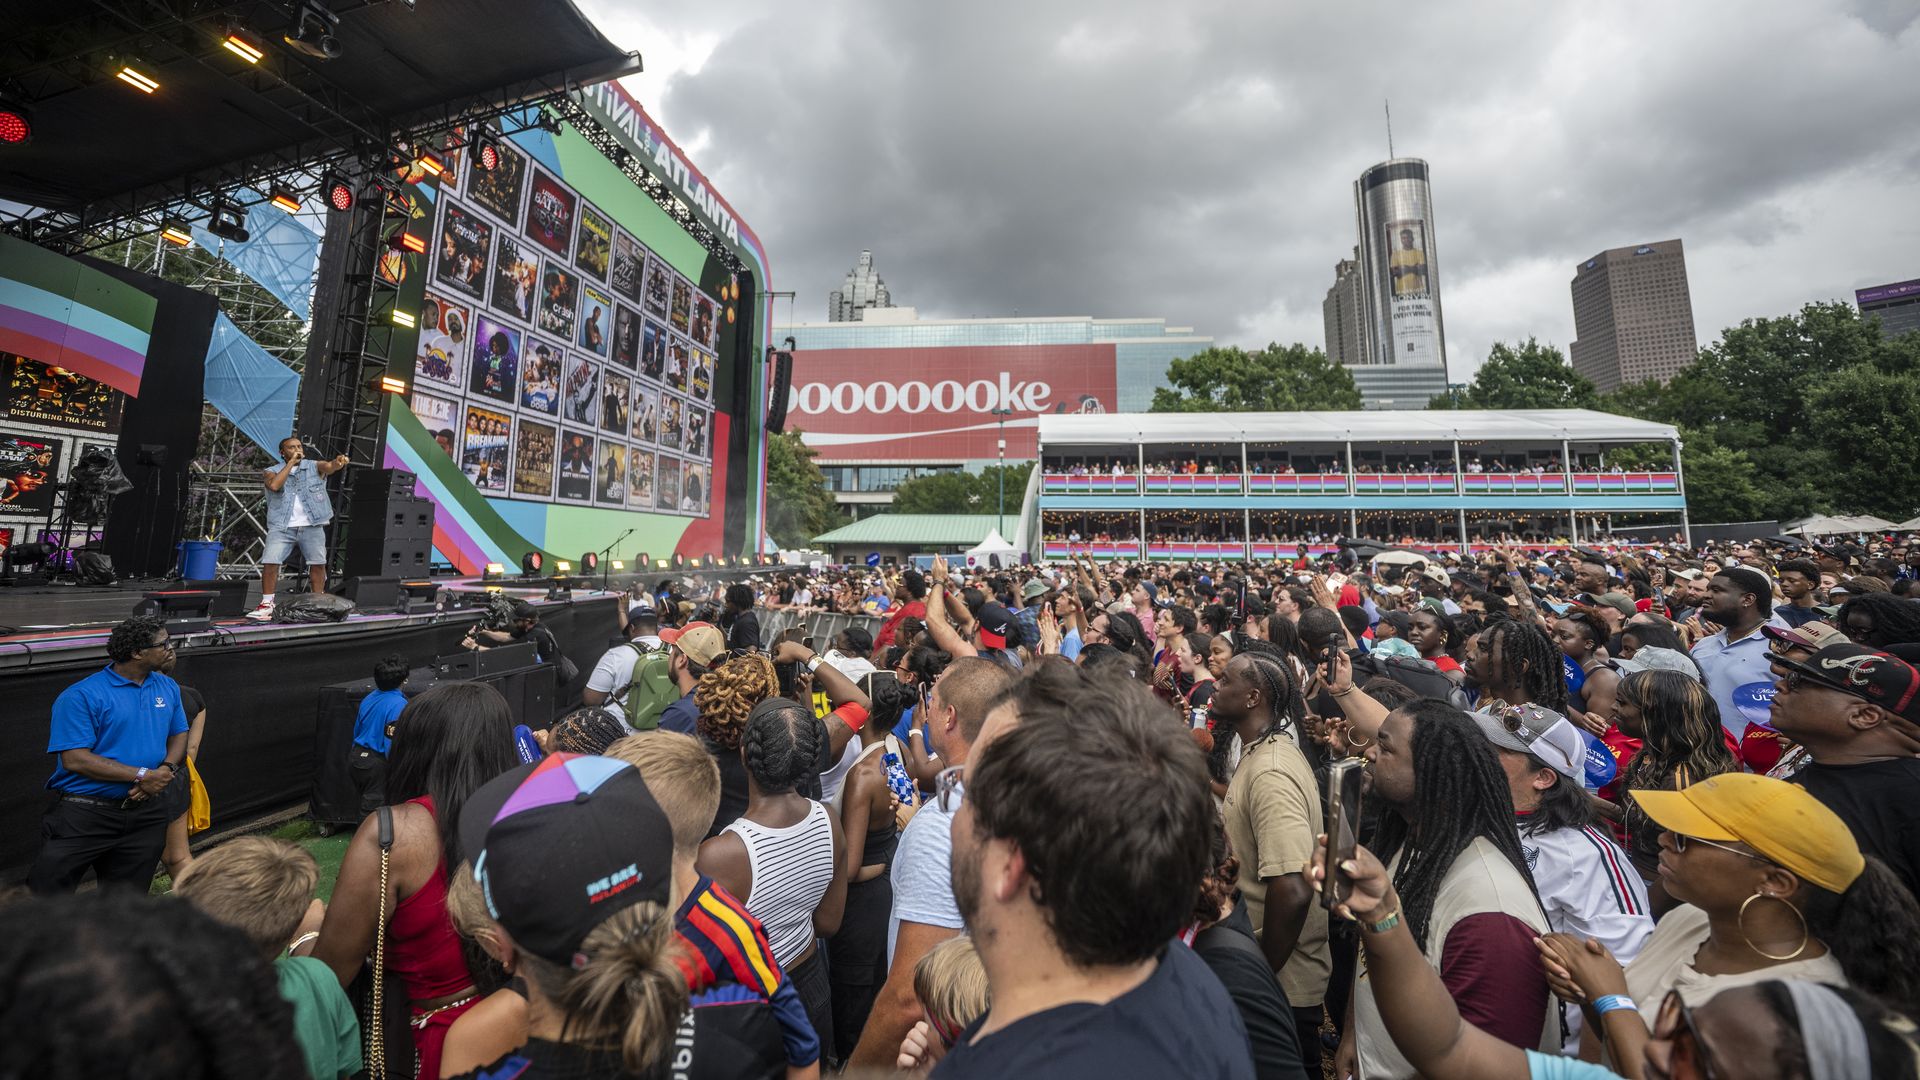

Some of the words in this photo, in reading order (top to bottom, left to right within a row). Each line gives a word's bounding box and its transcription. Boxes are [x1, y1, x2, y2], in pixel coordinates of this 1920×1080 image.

[654, 142, 739, 246] ATLANTA
[615, 263, 634, 281] ALL
[612, 275, 632, 290] BLACK
[552, 303, 575, 320] crash
[530, 400, 549, 412] DOGS
[10, 408, 62, 421] DISTURBING
[64, 416, 80, 424] THA
[81, 418, 107, 428] PEACE
[1747, 731, 1780, 739] ESPA
